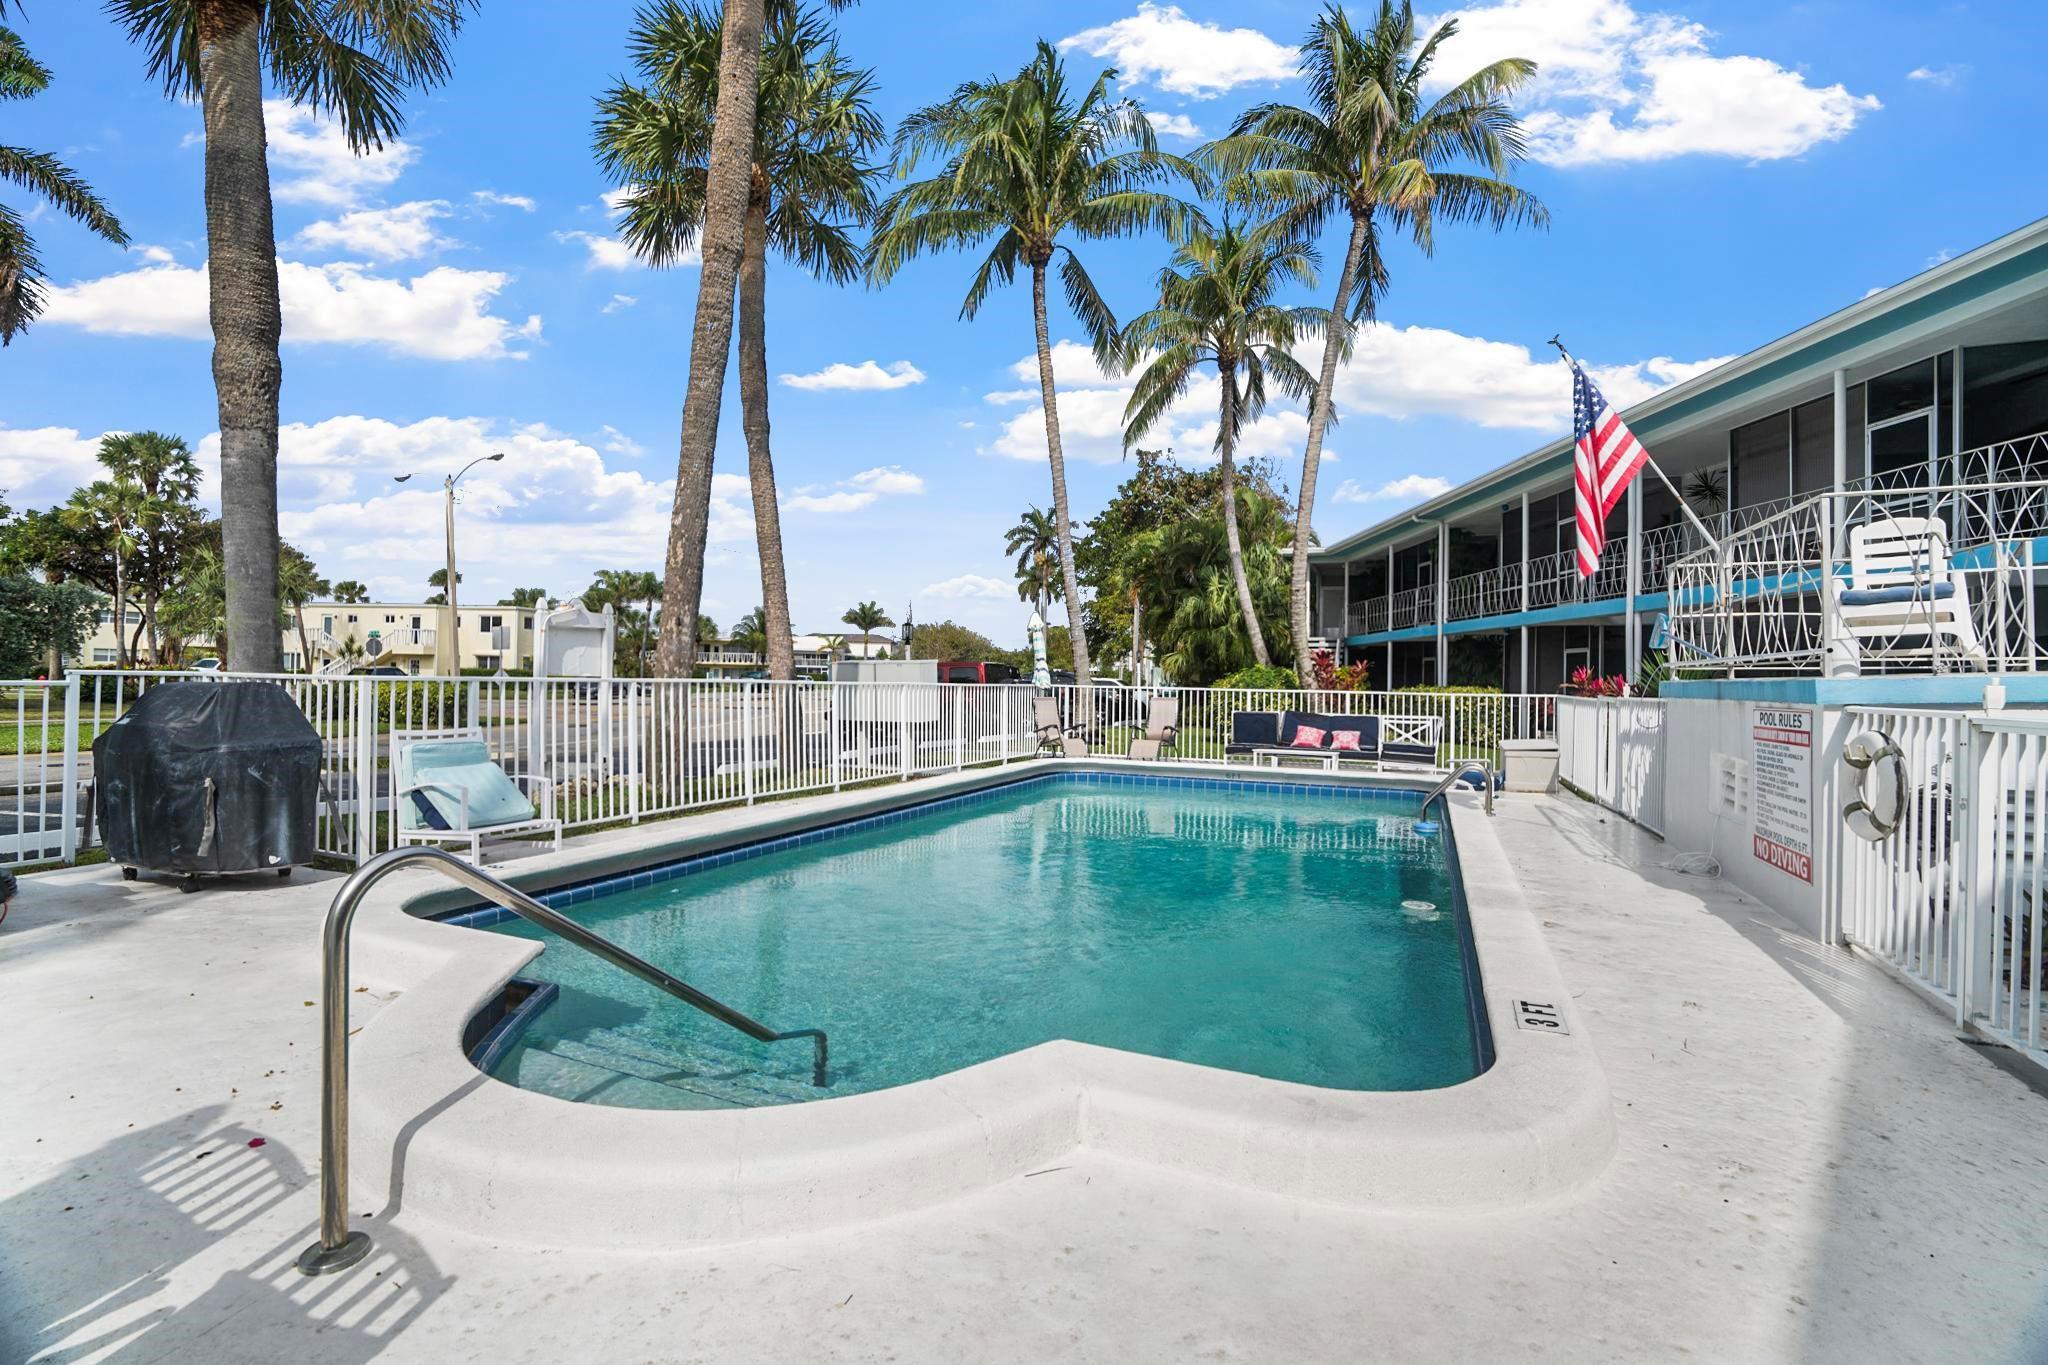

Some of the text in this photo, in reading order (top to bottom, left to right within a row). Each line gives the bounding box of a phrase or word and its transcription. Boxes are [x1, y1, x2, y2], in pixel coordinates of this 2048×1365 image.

[1760, 712, 1803, 728] POOL RULES
[1773, 831, 1783, 845] POOL
[1784, 836, 1798, 850] DEPTH
[1756, 836, 1808, 879] NO DIVING
[1520, 1000, 1560, 1027] 3 FT
